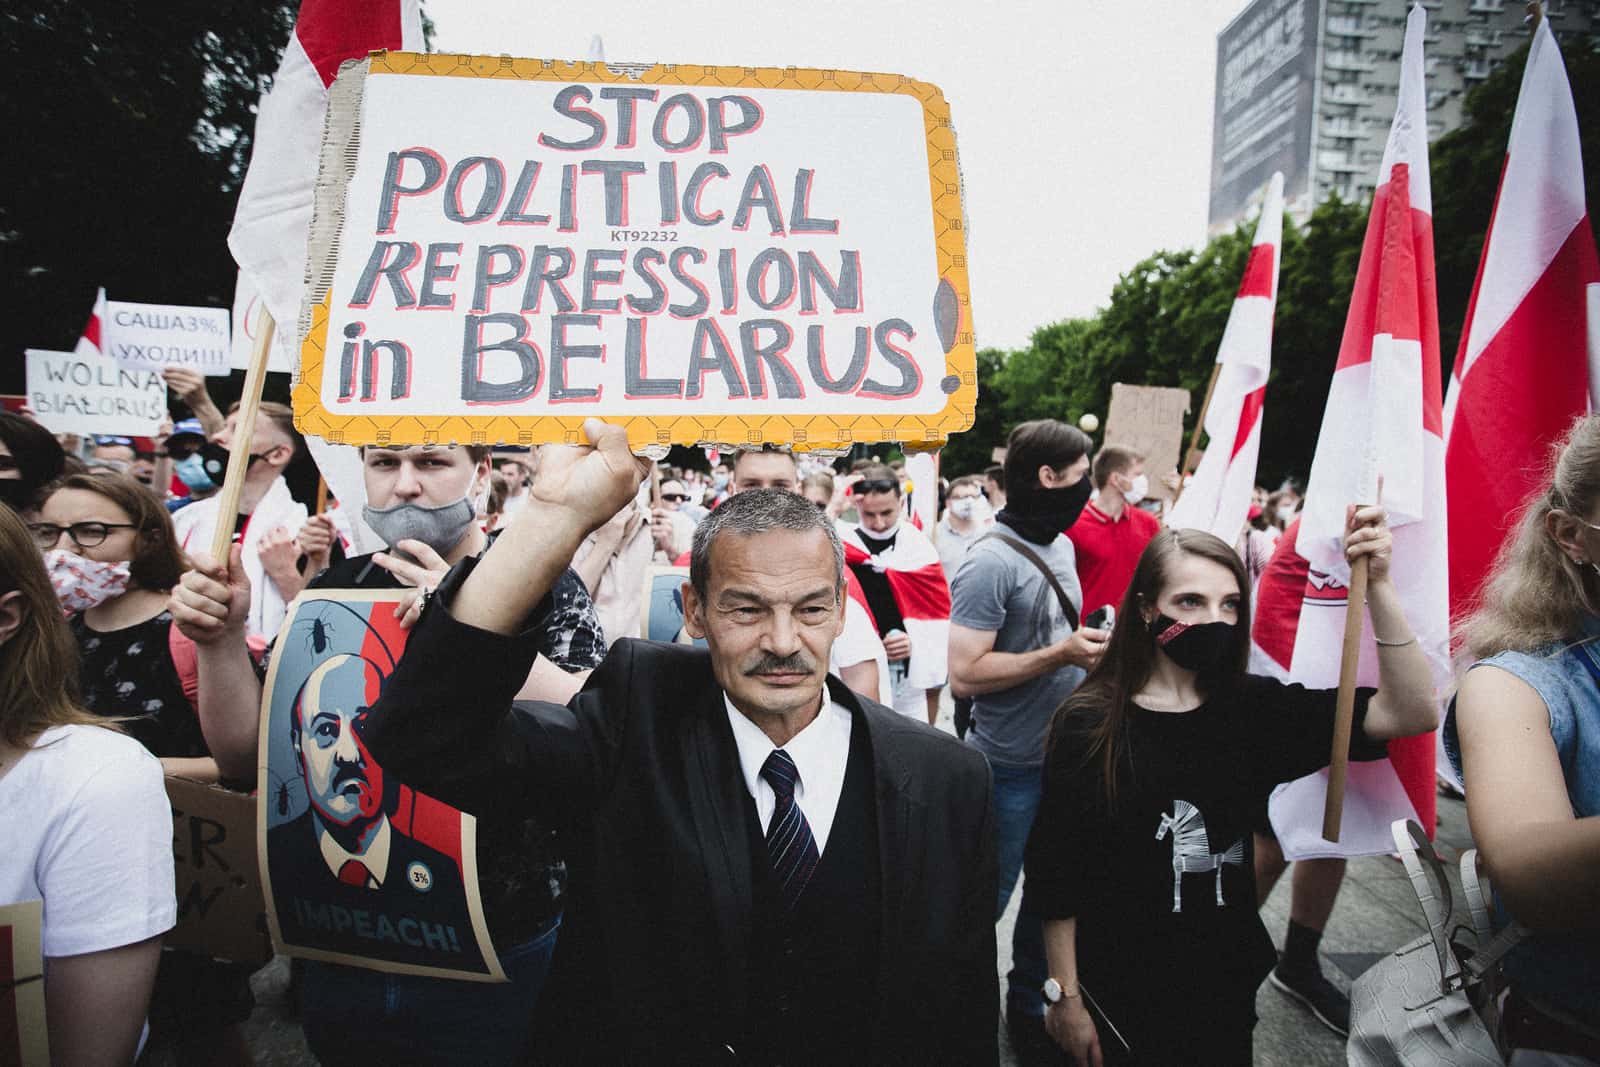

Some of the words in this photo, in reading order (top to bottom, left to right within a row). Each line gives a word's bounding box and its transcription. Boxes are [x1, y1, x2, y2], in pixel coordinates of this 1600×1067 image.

[538, 84, 765, 154] STOP
[376, 146, 839, 237] POLITICAL
[348, 241, 864, 316] REPRESSION
[43, 360, 166, 393] WOLNA
[117, 343, 224, 365] УХОДИ!!!
[336, 321, 413, 404] in
[413, 871, 429, 884] 3%
[294, 896, 462, 953] IMPEACH!
